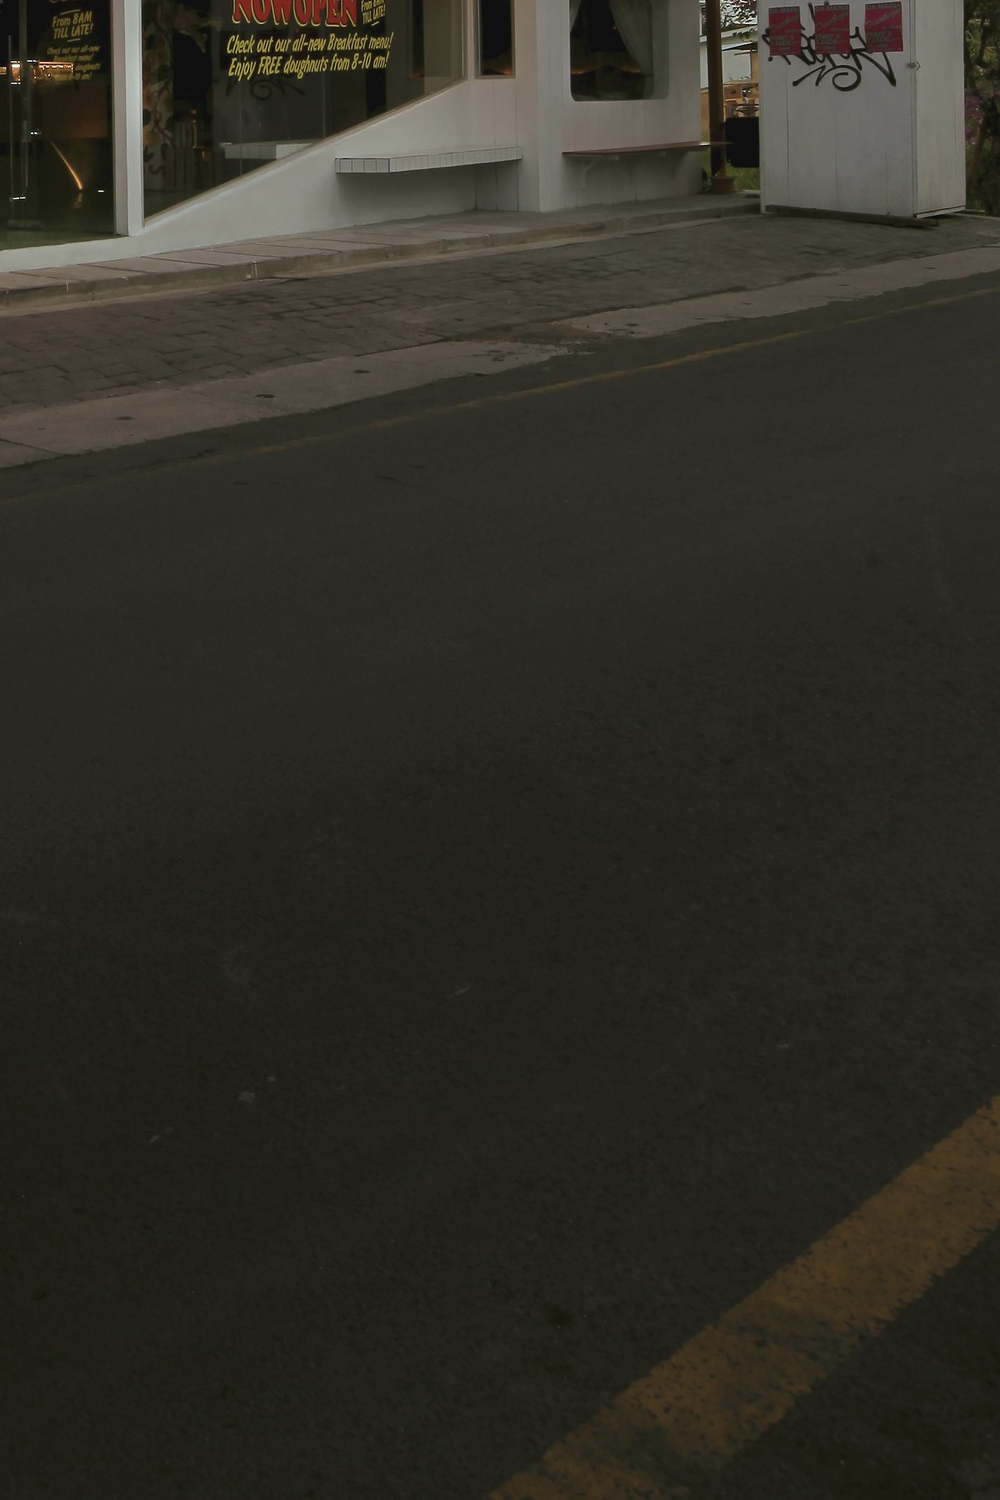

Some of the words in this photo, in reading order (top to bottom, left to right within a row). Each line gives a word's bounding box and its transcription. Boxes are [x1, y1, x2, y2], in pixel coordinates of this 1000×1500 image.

[361, 0, 373, 13] From
[362, 11, 373, 25] TILL
[373, 4, 386, 18] LATE!
[52, 15, 71, 29] From
[72, 10, 93, 25] 8AM
[53, 26, 69, 40] TILL
[71, 22, 94, 37] LATE!
[226, 35, 254, 54] Check
[256, 37, 274, 53] out
[275, 39, 291, 52] our
[292, 34, 326, 53] all-new
[327, 33, 369, 51] Breakfast
[368, 32, 394, 50] menu!
[228, 56, 258, 81] Enjoy
[257, 55, 283, 76] FREE
[283, 56, 329, 80] doughnuts
[329, 55, 350, 71] from
[351, 52, 371, 70] 8-10
[373, 51, 389, 69] am!
